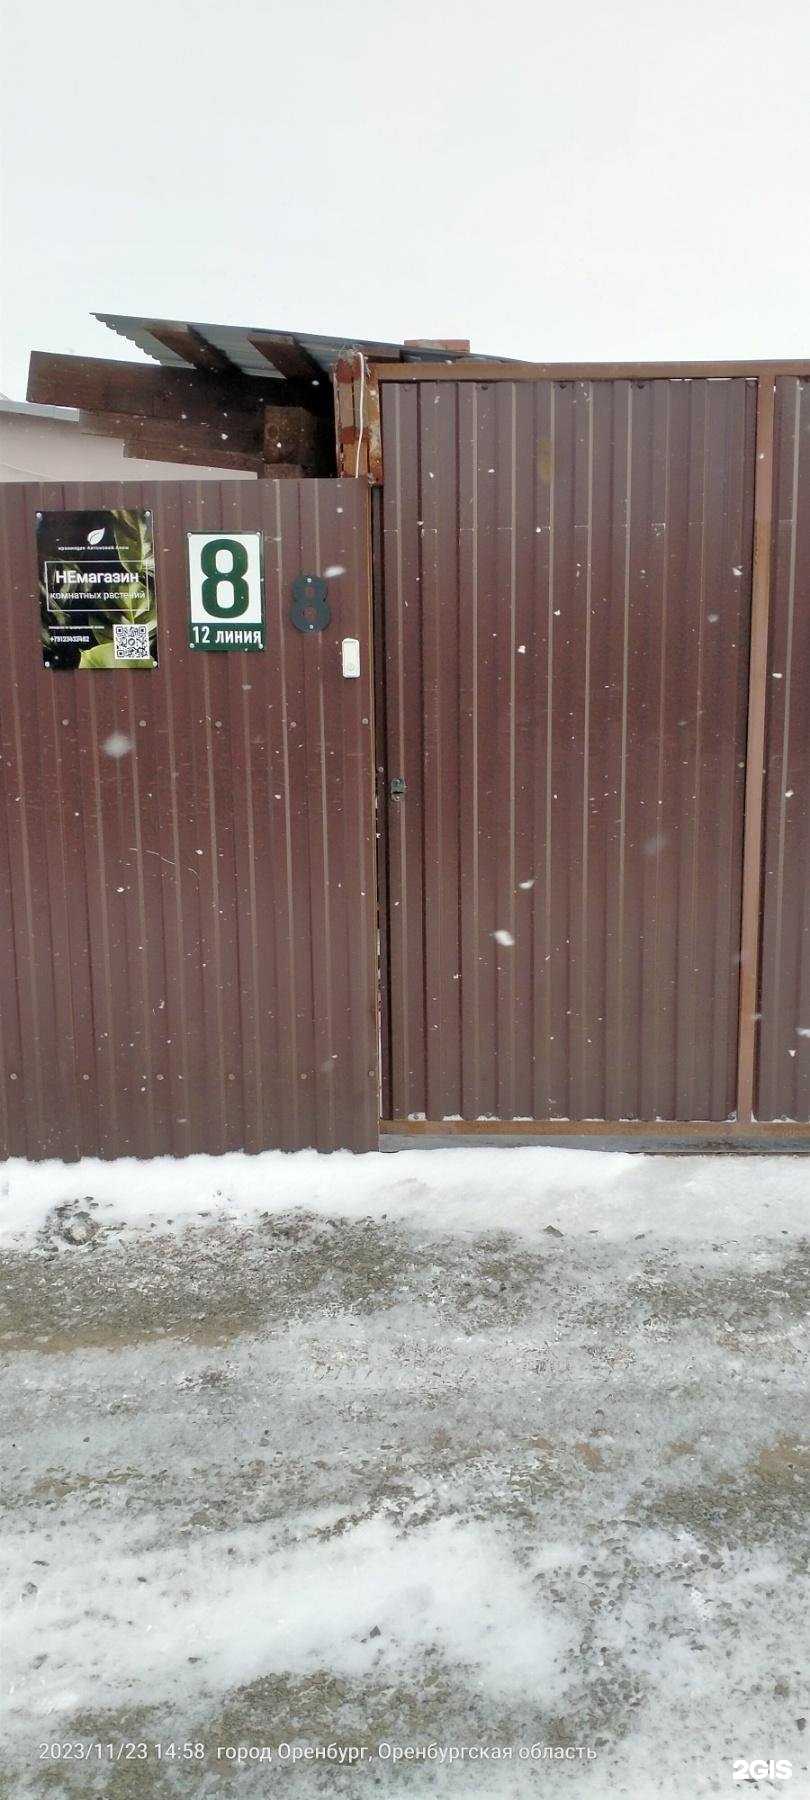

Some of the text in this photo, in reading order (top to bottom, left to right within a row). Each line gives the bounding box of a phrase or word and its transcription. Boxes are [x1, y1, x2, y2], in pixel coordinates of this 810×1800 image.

[55, 570, 139, 584] НЕмагазин
[200, 538, 250, 619] 8
[49, 591, 145, 601] комнатных растений
[290, 574, 330, 633] 8
[192, 625, 262, 644] 12 линия
